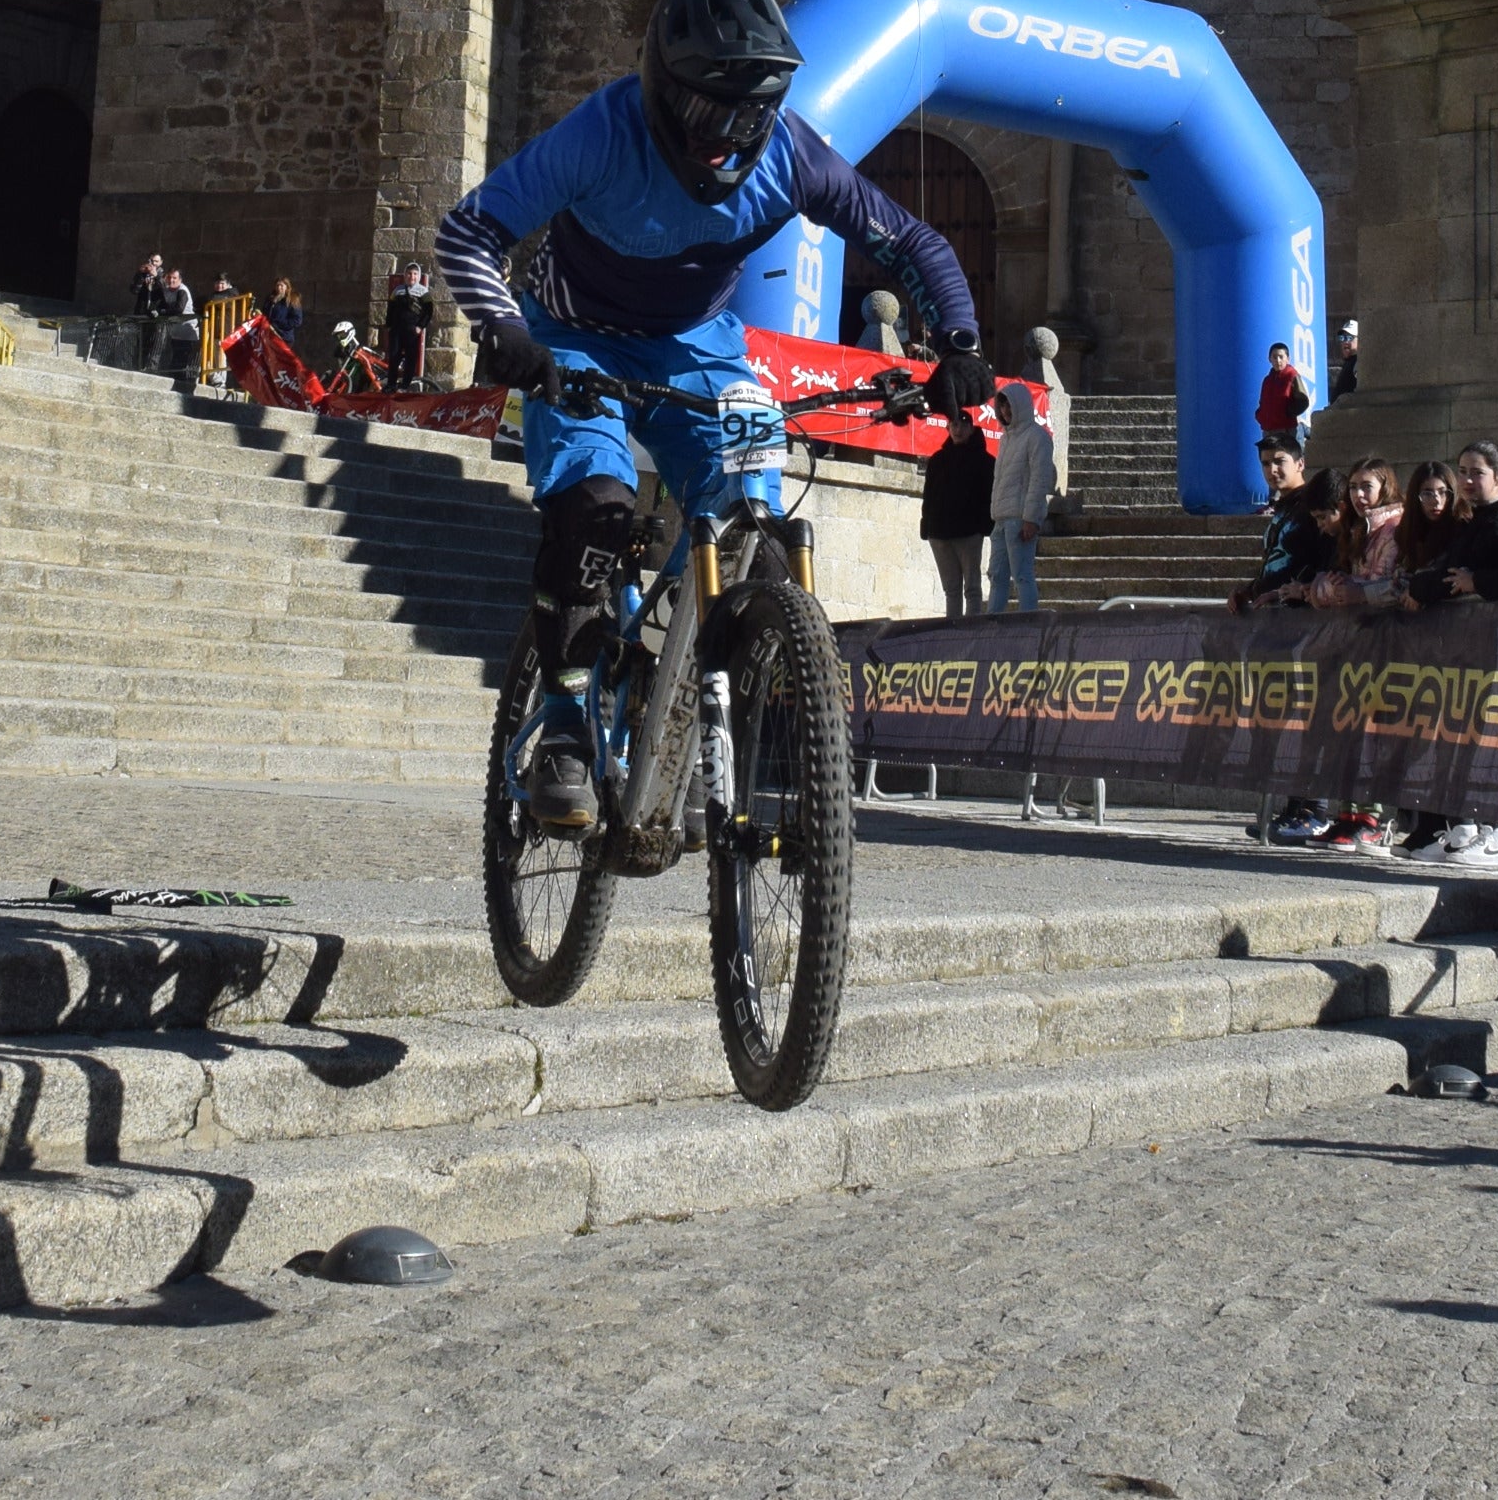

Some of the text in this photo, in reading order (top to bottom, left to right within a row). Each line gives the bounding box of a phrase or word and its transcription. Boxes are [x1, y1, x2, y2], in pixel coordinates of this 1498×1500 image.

[967, 4, 1181, 79] ORBEA
[1291, 225, 1317, 428] BEA
[722, 412, 772, 448] 95
